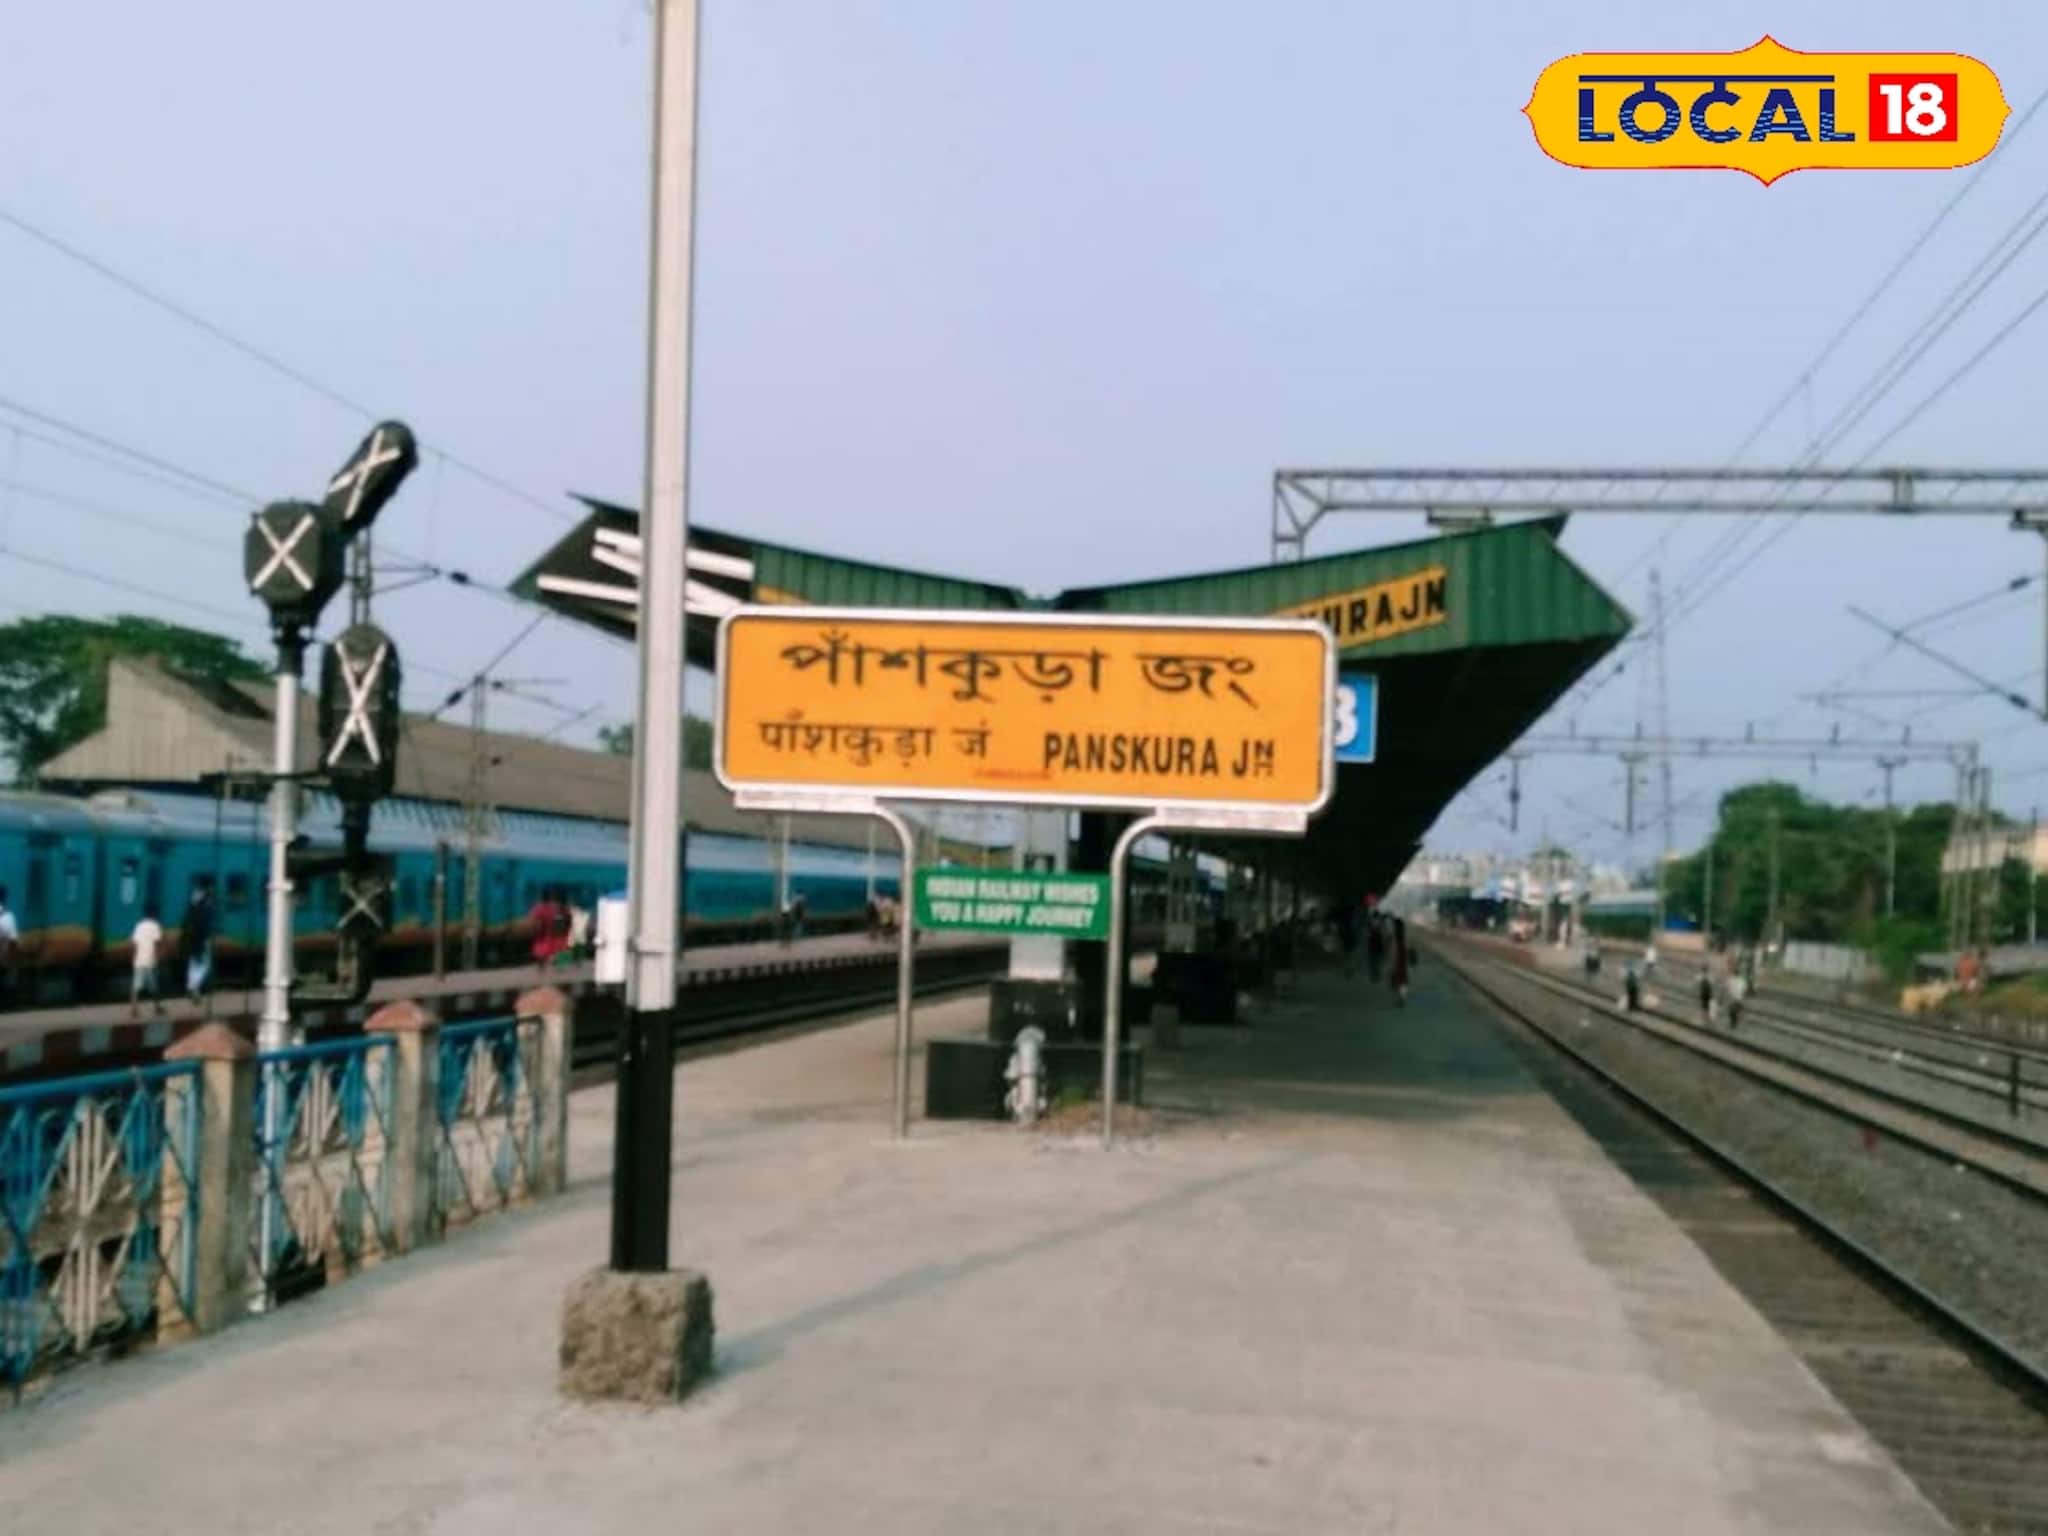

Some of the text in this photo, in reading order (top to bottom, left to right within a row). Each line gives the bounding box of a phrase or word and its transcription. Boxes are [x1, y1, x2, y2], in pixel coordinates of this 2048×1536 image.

[779, 628, 1259, 709] পাঁশকুড়া জং
[1043, 732, 1220, 776] PANSKURA
